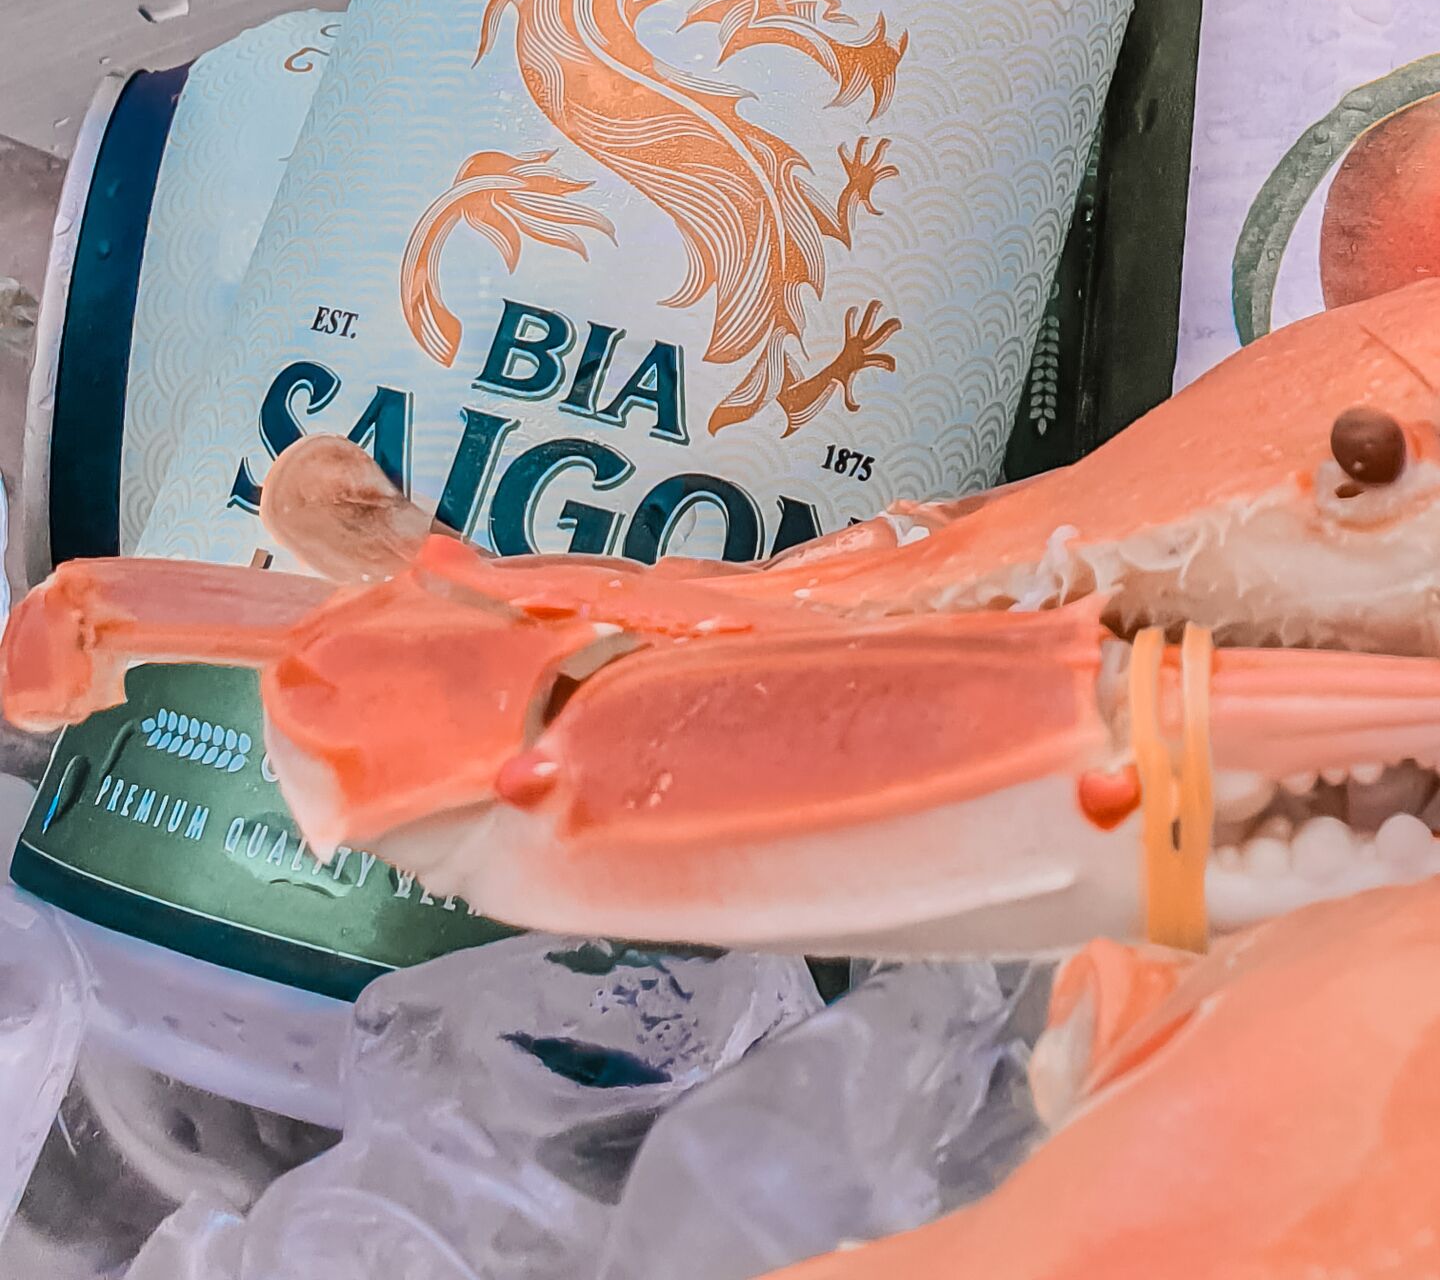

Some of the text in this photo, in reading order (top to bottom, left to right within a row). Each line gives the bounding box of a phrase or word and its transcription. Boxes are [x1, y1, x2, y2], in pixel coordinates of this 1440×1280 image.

[310, 305, 360, 340] EST.
[471, 297, 691, 447] BIA
[821, 443, 876, 483] 1875
[94, 774, 211, 841] PREMIUM
